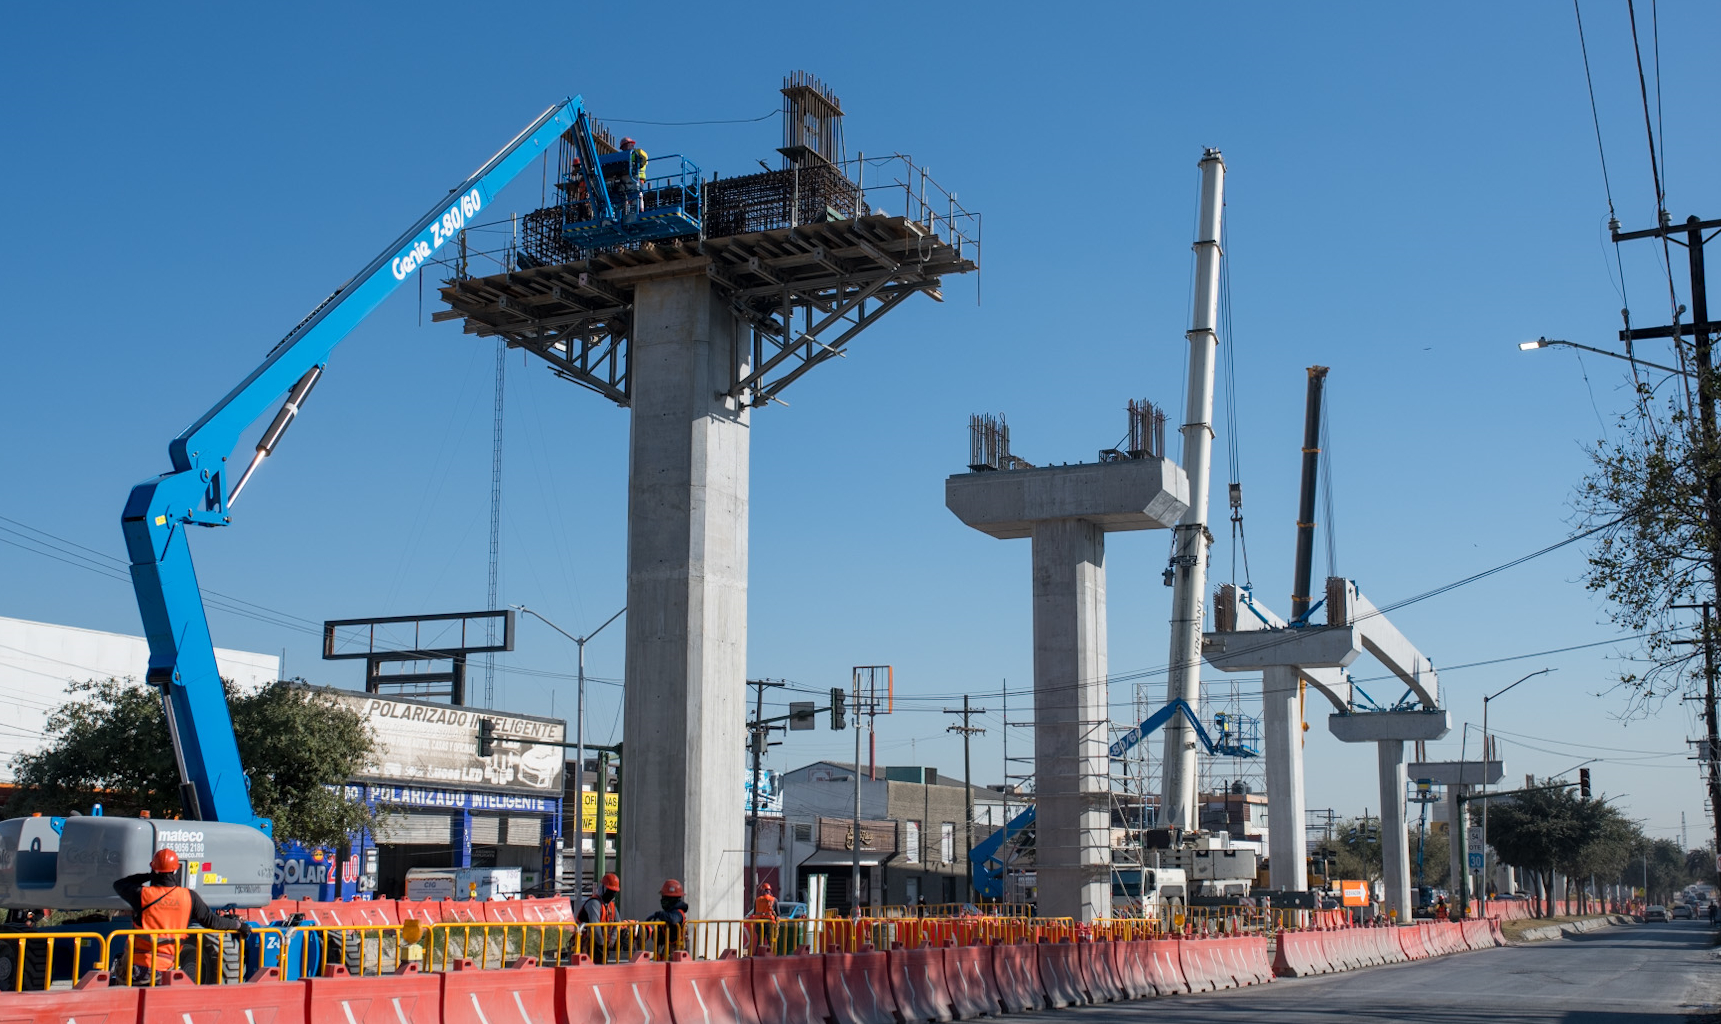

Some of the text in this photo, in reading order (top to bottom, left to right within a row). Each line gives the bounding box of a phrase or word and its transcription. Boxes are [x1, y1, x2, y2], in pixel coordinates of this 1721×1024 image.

[391, 188, 481, 281] Genie Z-80/60
[369, 700, 467, 727] POLARIZADO
[1110, 728, 1143, 757] -80/60
[370, 786, 465, 807] POLARIZADO
[472, 793, 545, 811] INTELIGENTE
[584, 795, 618, 807] OFINAS
[158, 829, 204, 842] mateco
[190, 843, 205, 852] 2180
[273, 858, 327, 884] SOLAR
[1470, 856, 1481, 867] 30
